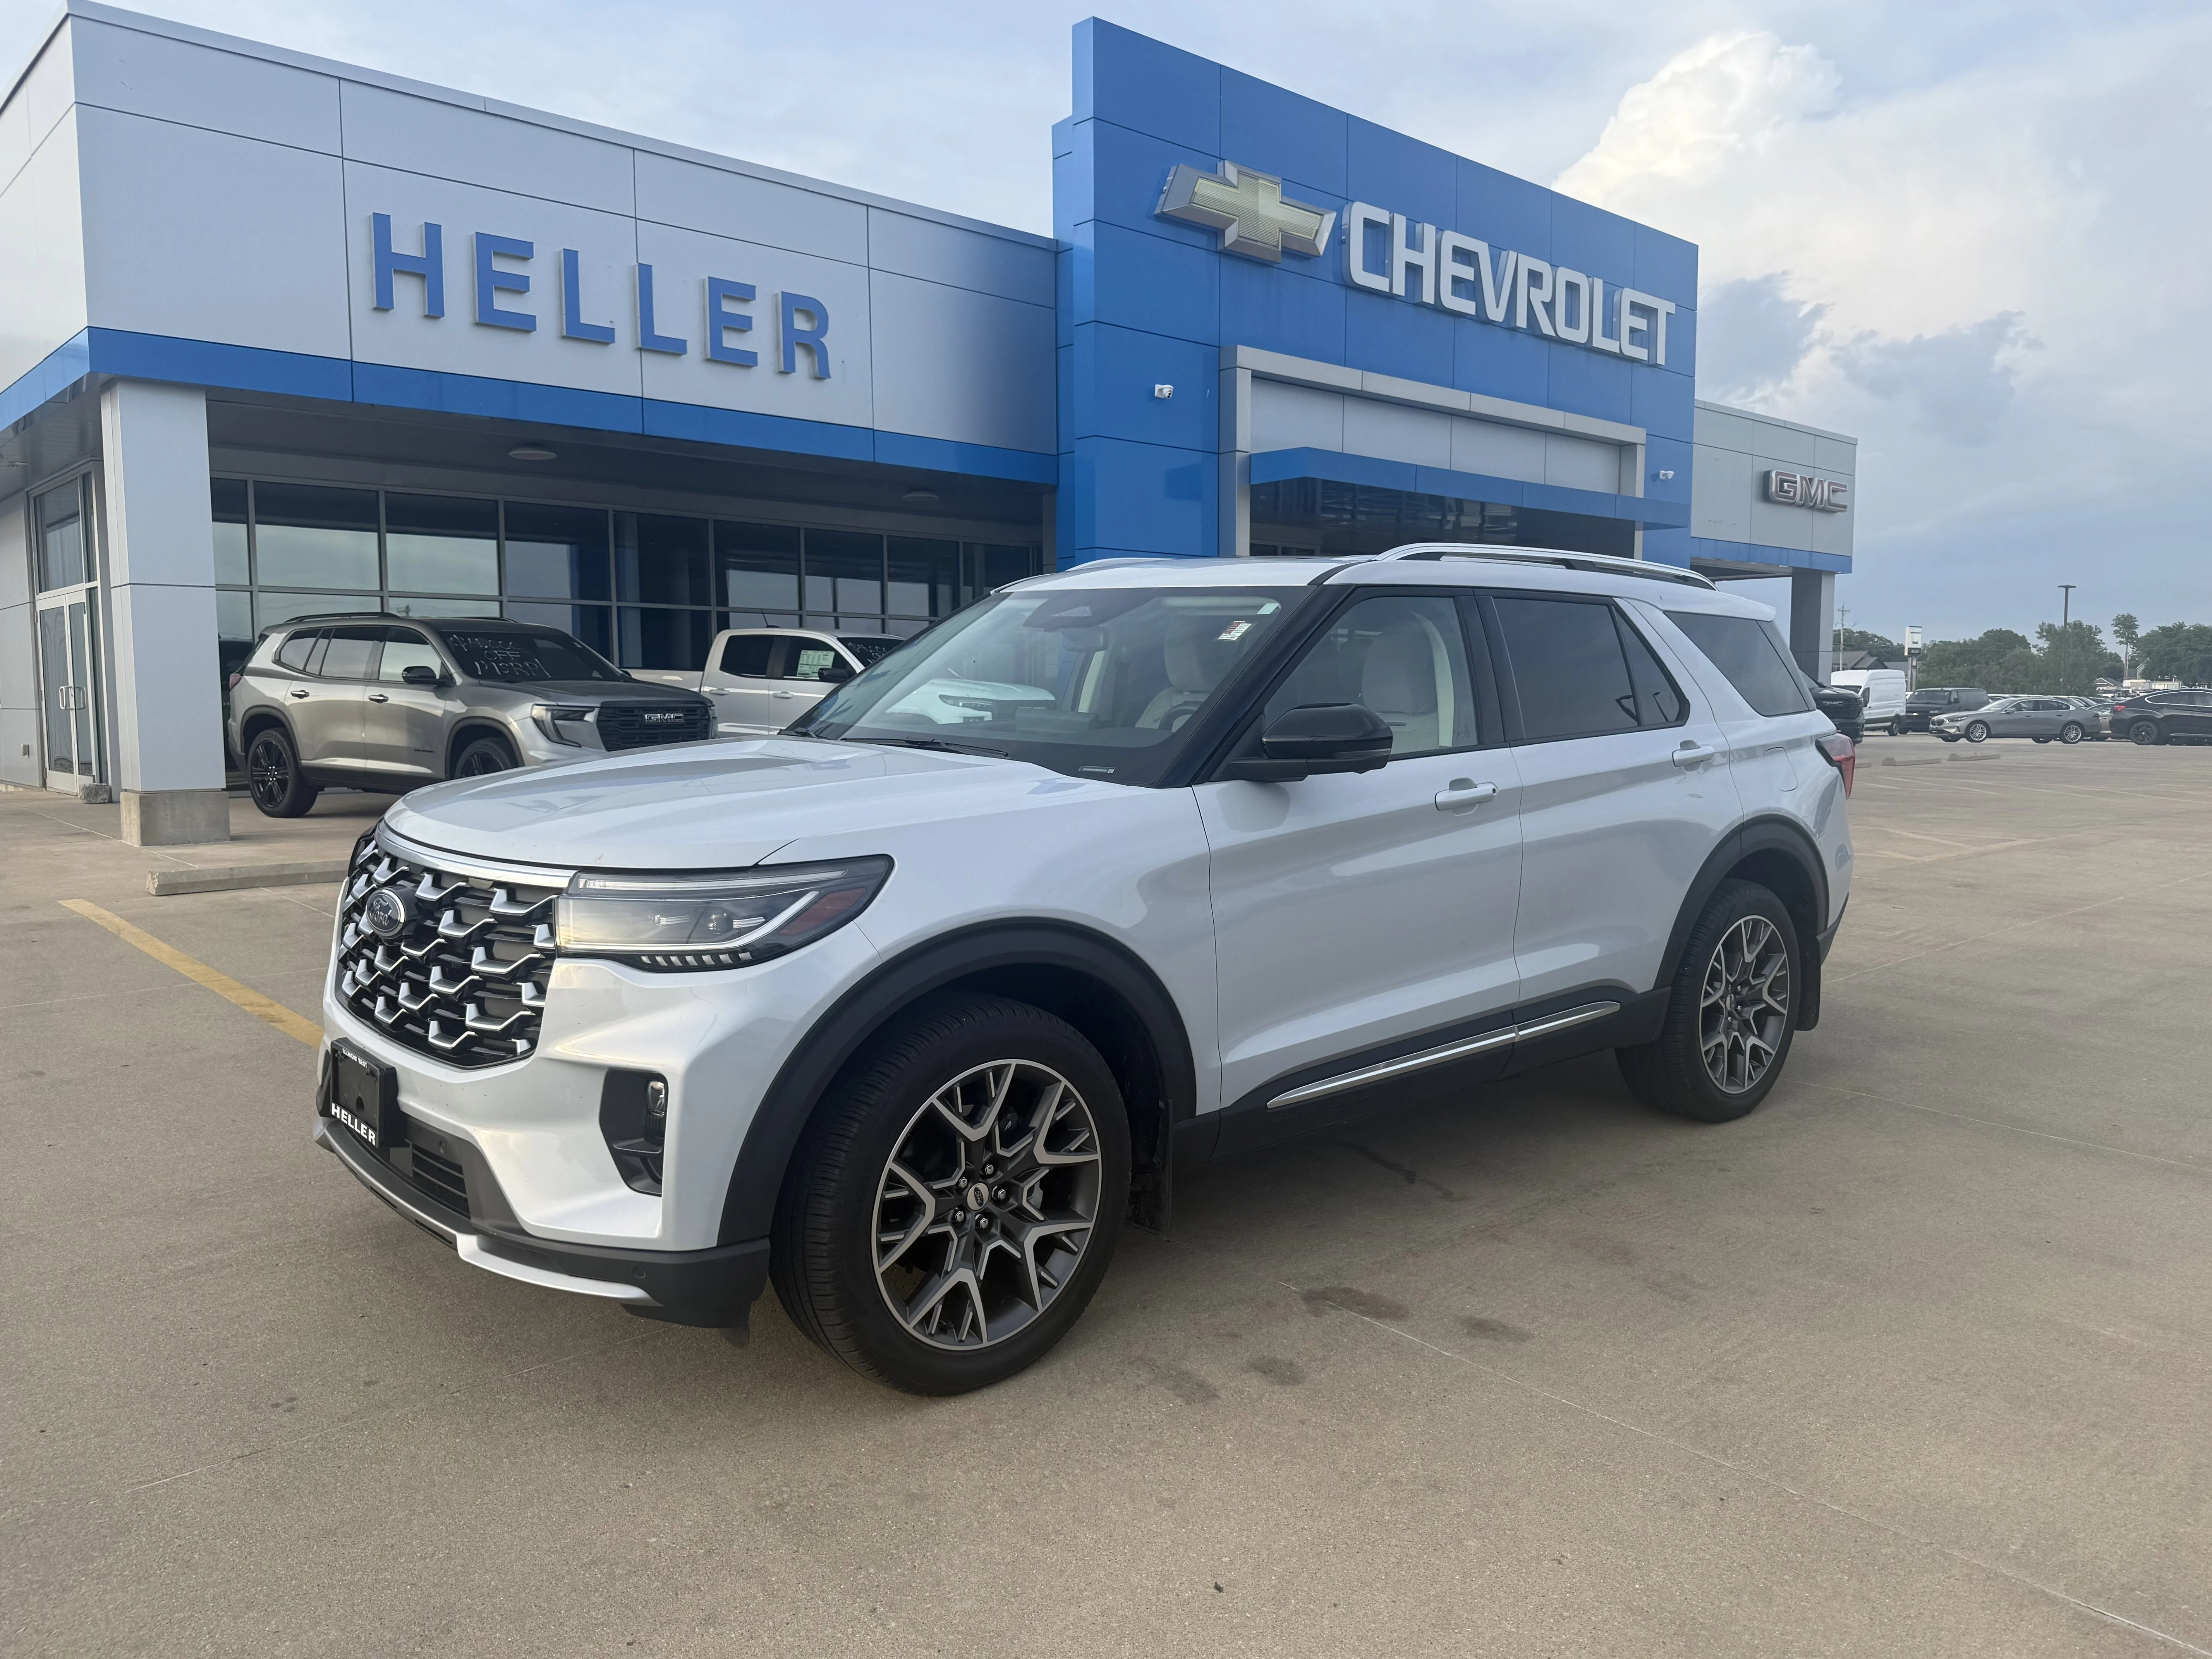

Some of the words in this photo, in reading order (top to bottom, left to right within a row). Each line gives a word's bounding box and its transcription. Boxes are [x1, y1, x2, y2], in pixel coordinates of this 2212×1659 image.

[369, 212, 831, 379] HELLER
[1342, 201, 1676, 366] CHEVROLET
[1769, 469, 1849, 513] GMC
[484, 650, 520, 660] OFF
[644, 713, 684, 723] GMC
[369, 897, 392, 926] Ford
[358, 1057, 368, 1068] BEST
[331, 1103, 376, 1146] HELLER
